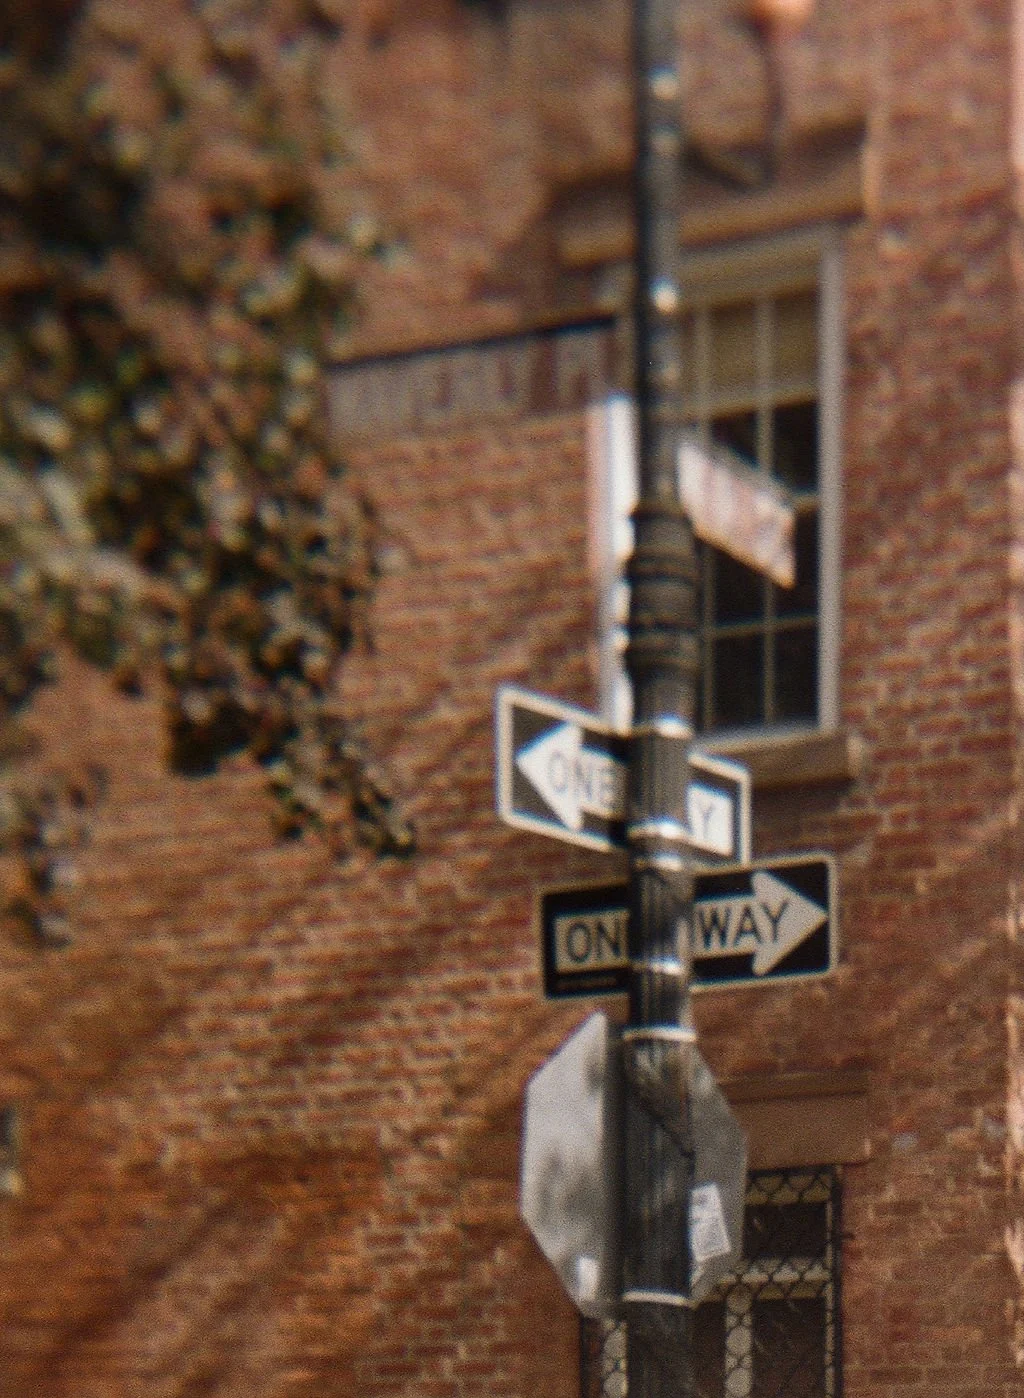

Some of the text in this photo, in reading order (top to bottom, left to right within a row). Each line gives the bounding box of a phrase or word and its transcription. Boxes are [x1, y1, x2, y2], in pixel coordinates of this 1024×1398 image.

[548, 751, 617, 807] ONE
[567, 897, 792, 963] ON WAY
